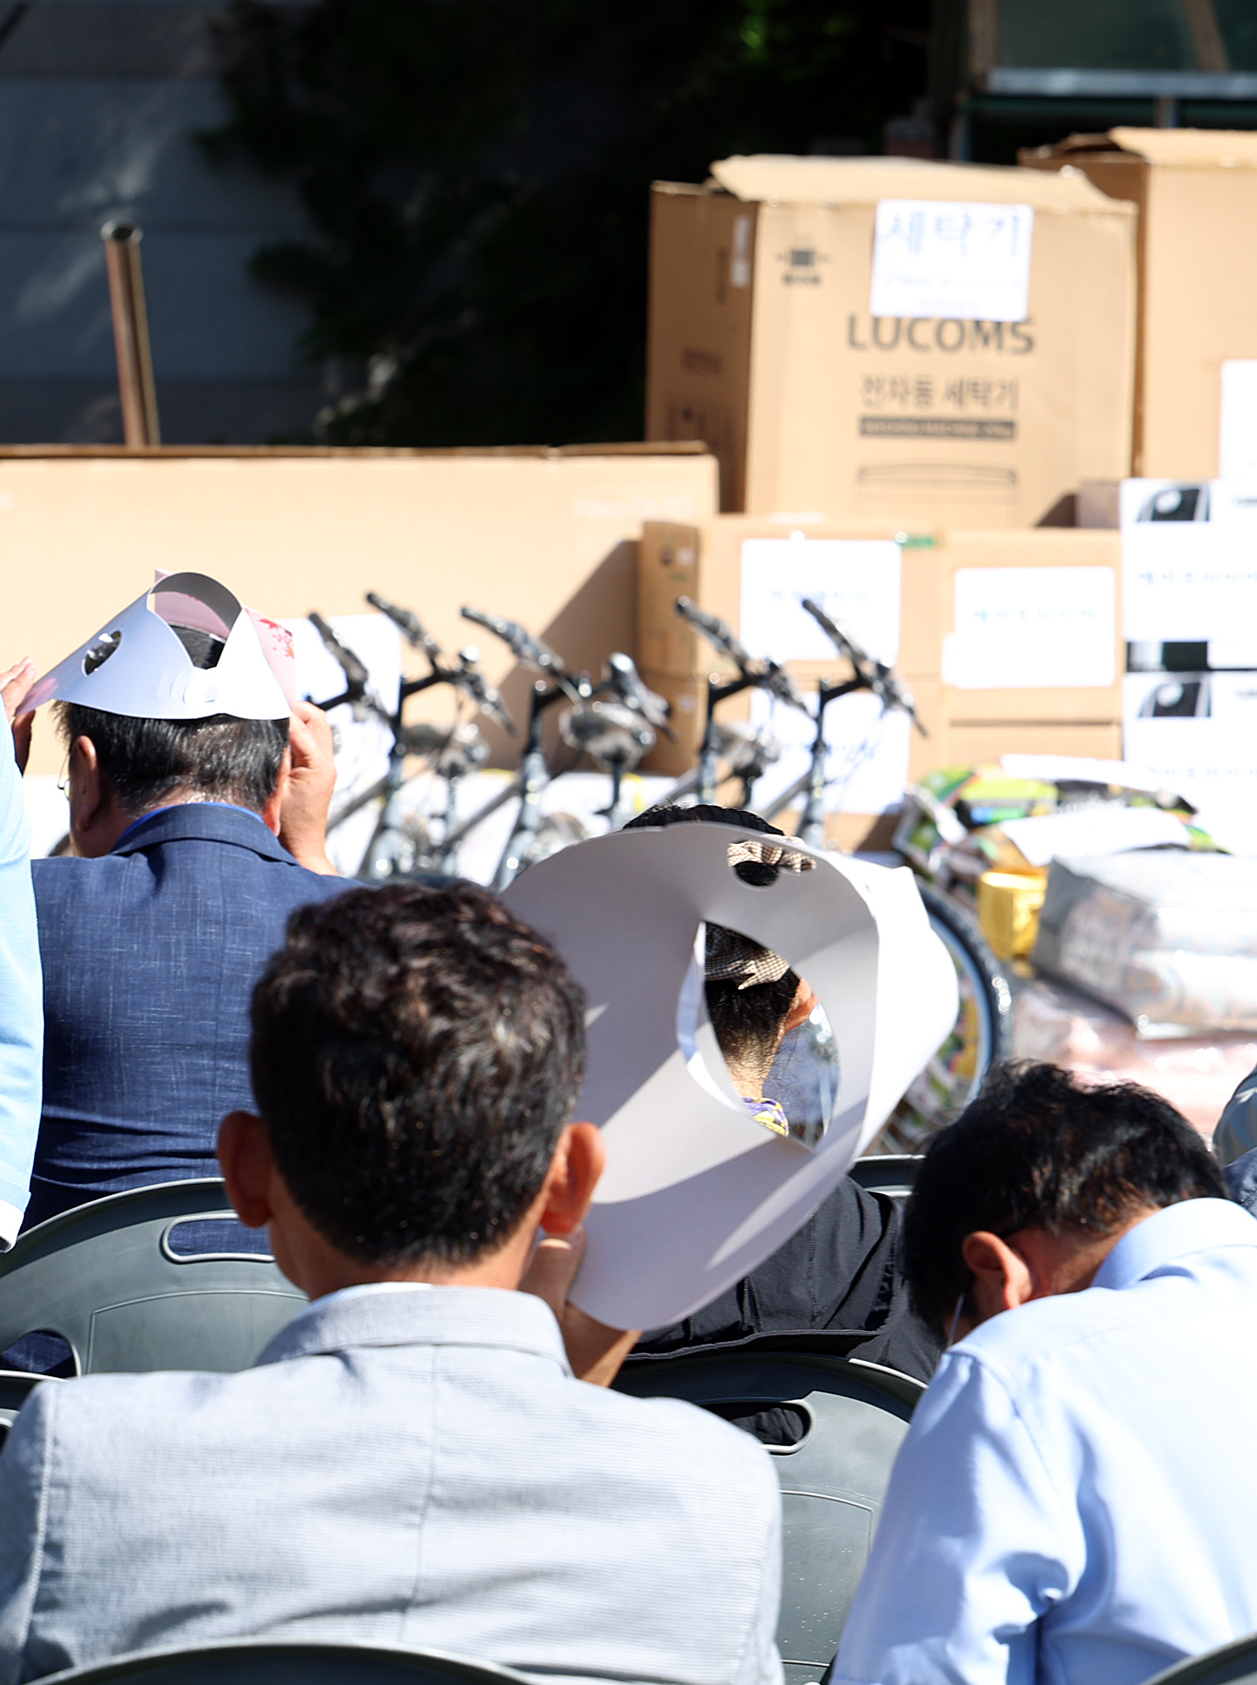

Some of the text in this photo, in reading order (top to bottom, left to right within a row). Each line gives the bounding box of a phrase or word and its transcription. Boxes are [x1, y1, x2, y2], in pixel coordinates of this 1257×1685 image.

[884, 210, 1022, 257] 세탁기
[848, 316, 1035, 354] LUCOMS
[862, 374, 1019, 410] 전자동 세탁기
